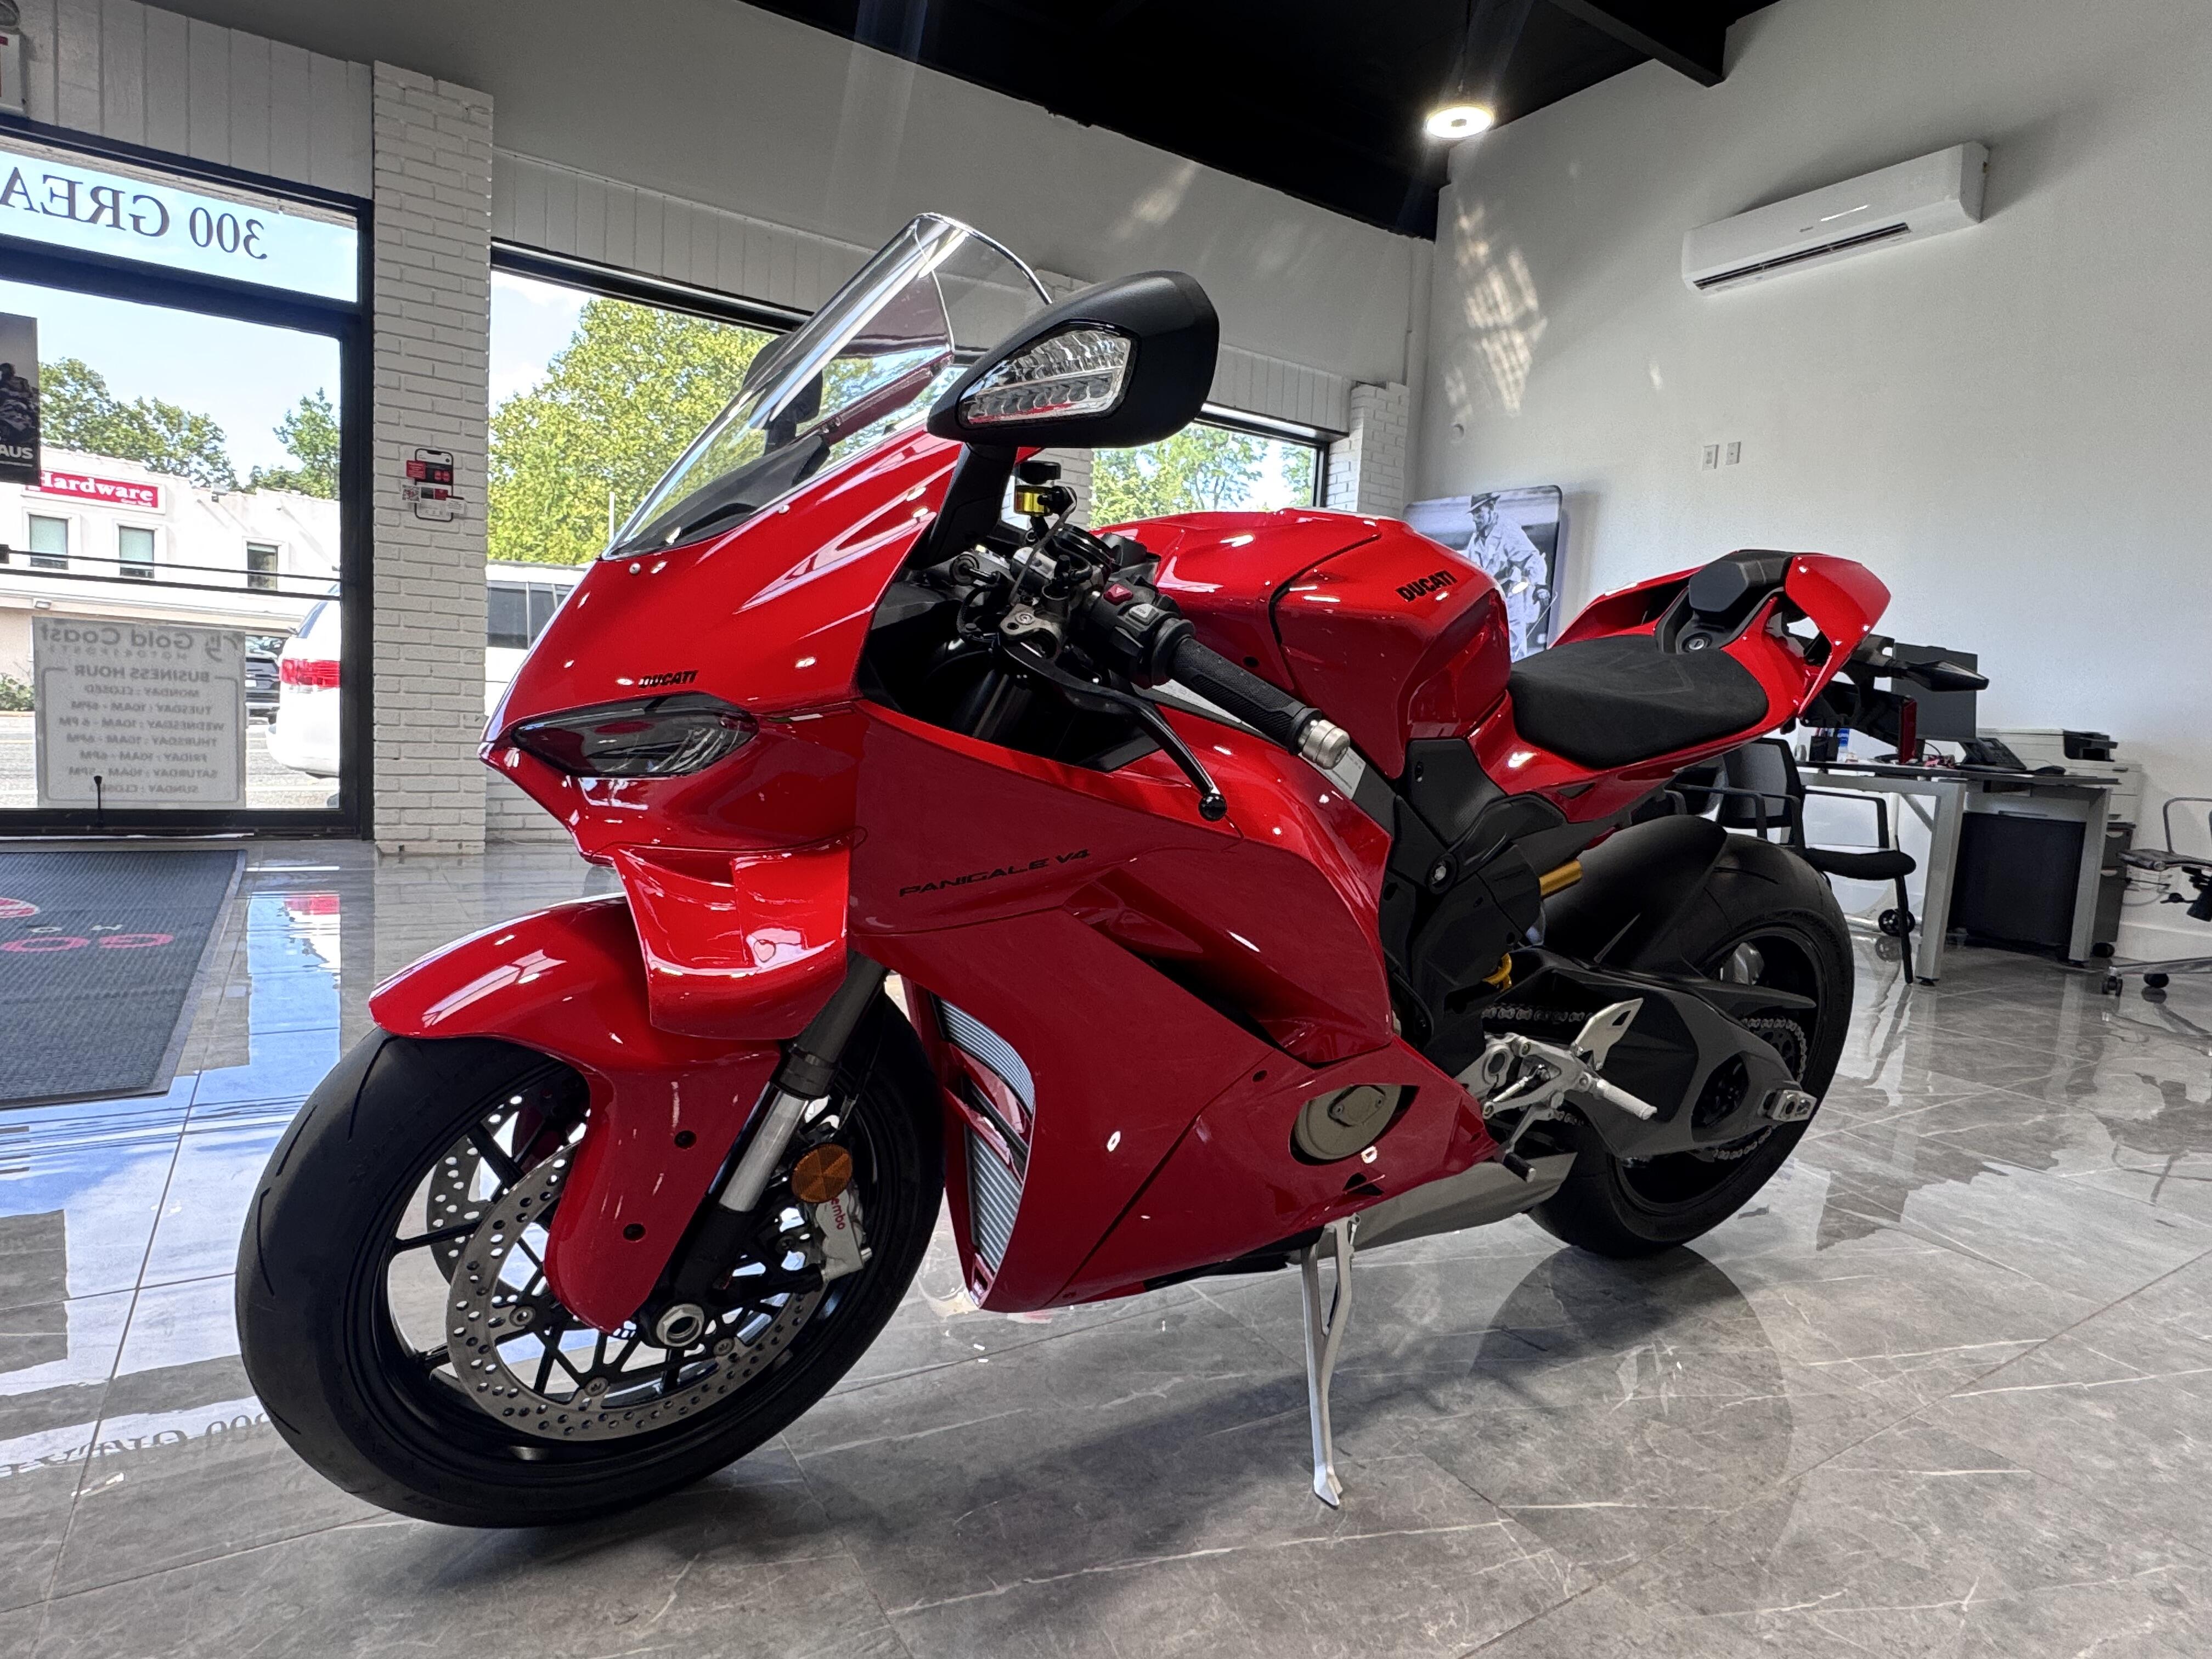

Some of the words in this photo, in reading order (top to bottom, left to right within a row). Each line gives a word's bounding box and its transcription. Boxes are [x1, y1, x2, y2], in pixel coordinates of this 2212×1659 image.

[1395, 570, 1458, 602] DUCATI
[638, 669, 699, 689] DUCATI
[899, 857, 1049, 898] PANIGALE
[1055, 849, 1091, 864] V4
[831, 1198, 846, 1230] embo
